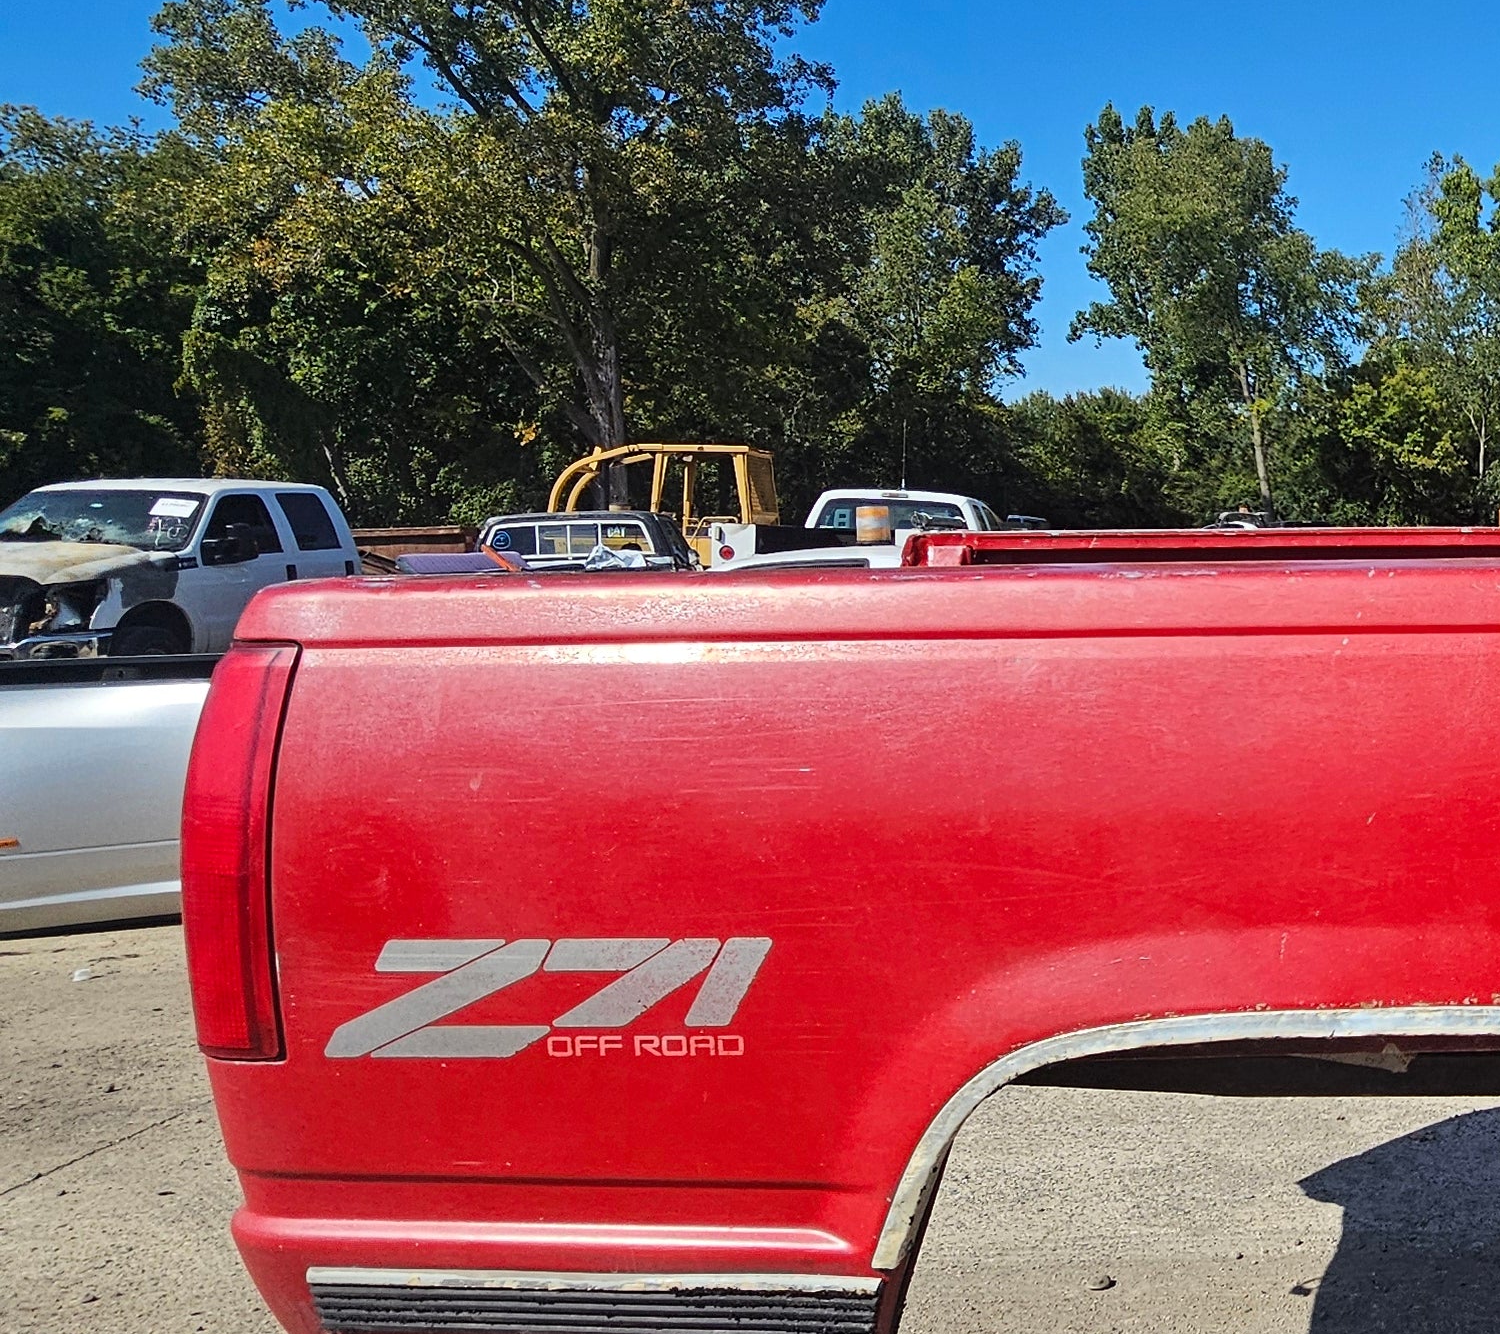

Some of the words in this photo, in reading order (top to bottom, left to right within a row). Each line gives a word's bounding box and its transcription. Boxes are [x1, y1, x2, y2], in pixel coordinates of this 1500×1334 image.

[608, 526, 626, 538] CAT
[324, 937, 773, 1058] Z71
[546, 1035, 623, 1057] OFF
[633, 1034, 745, 1057] ROAD
